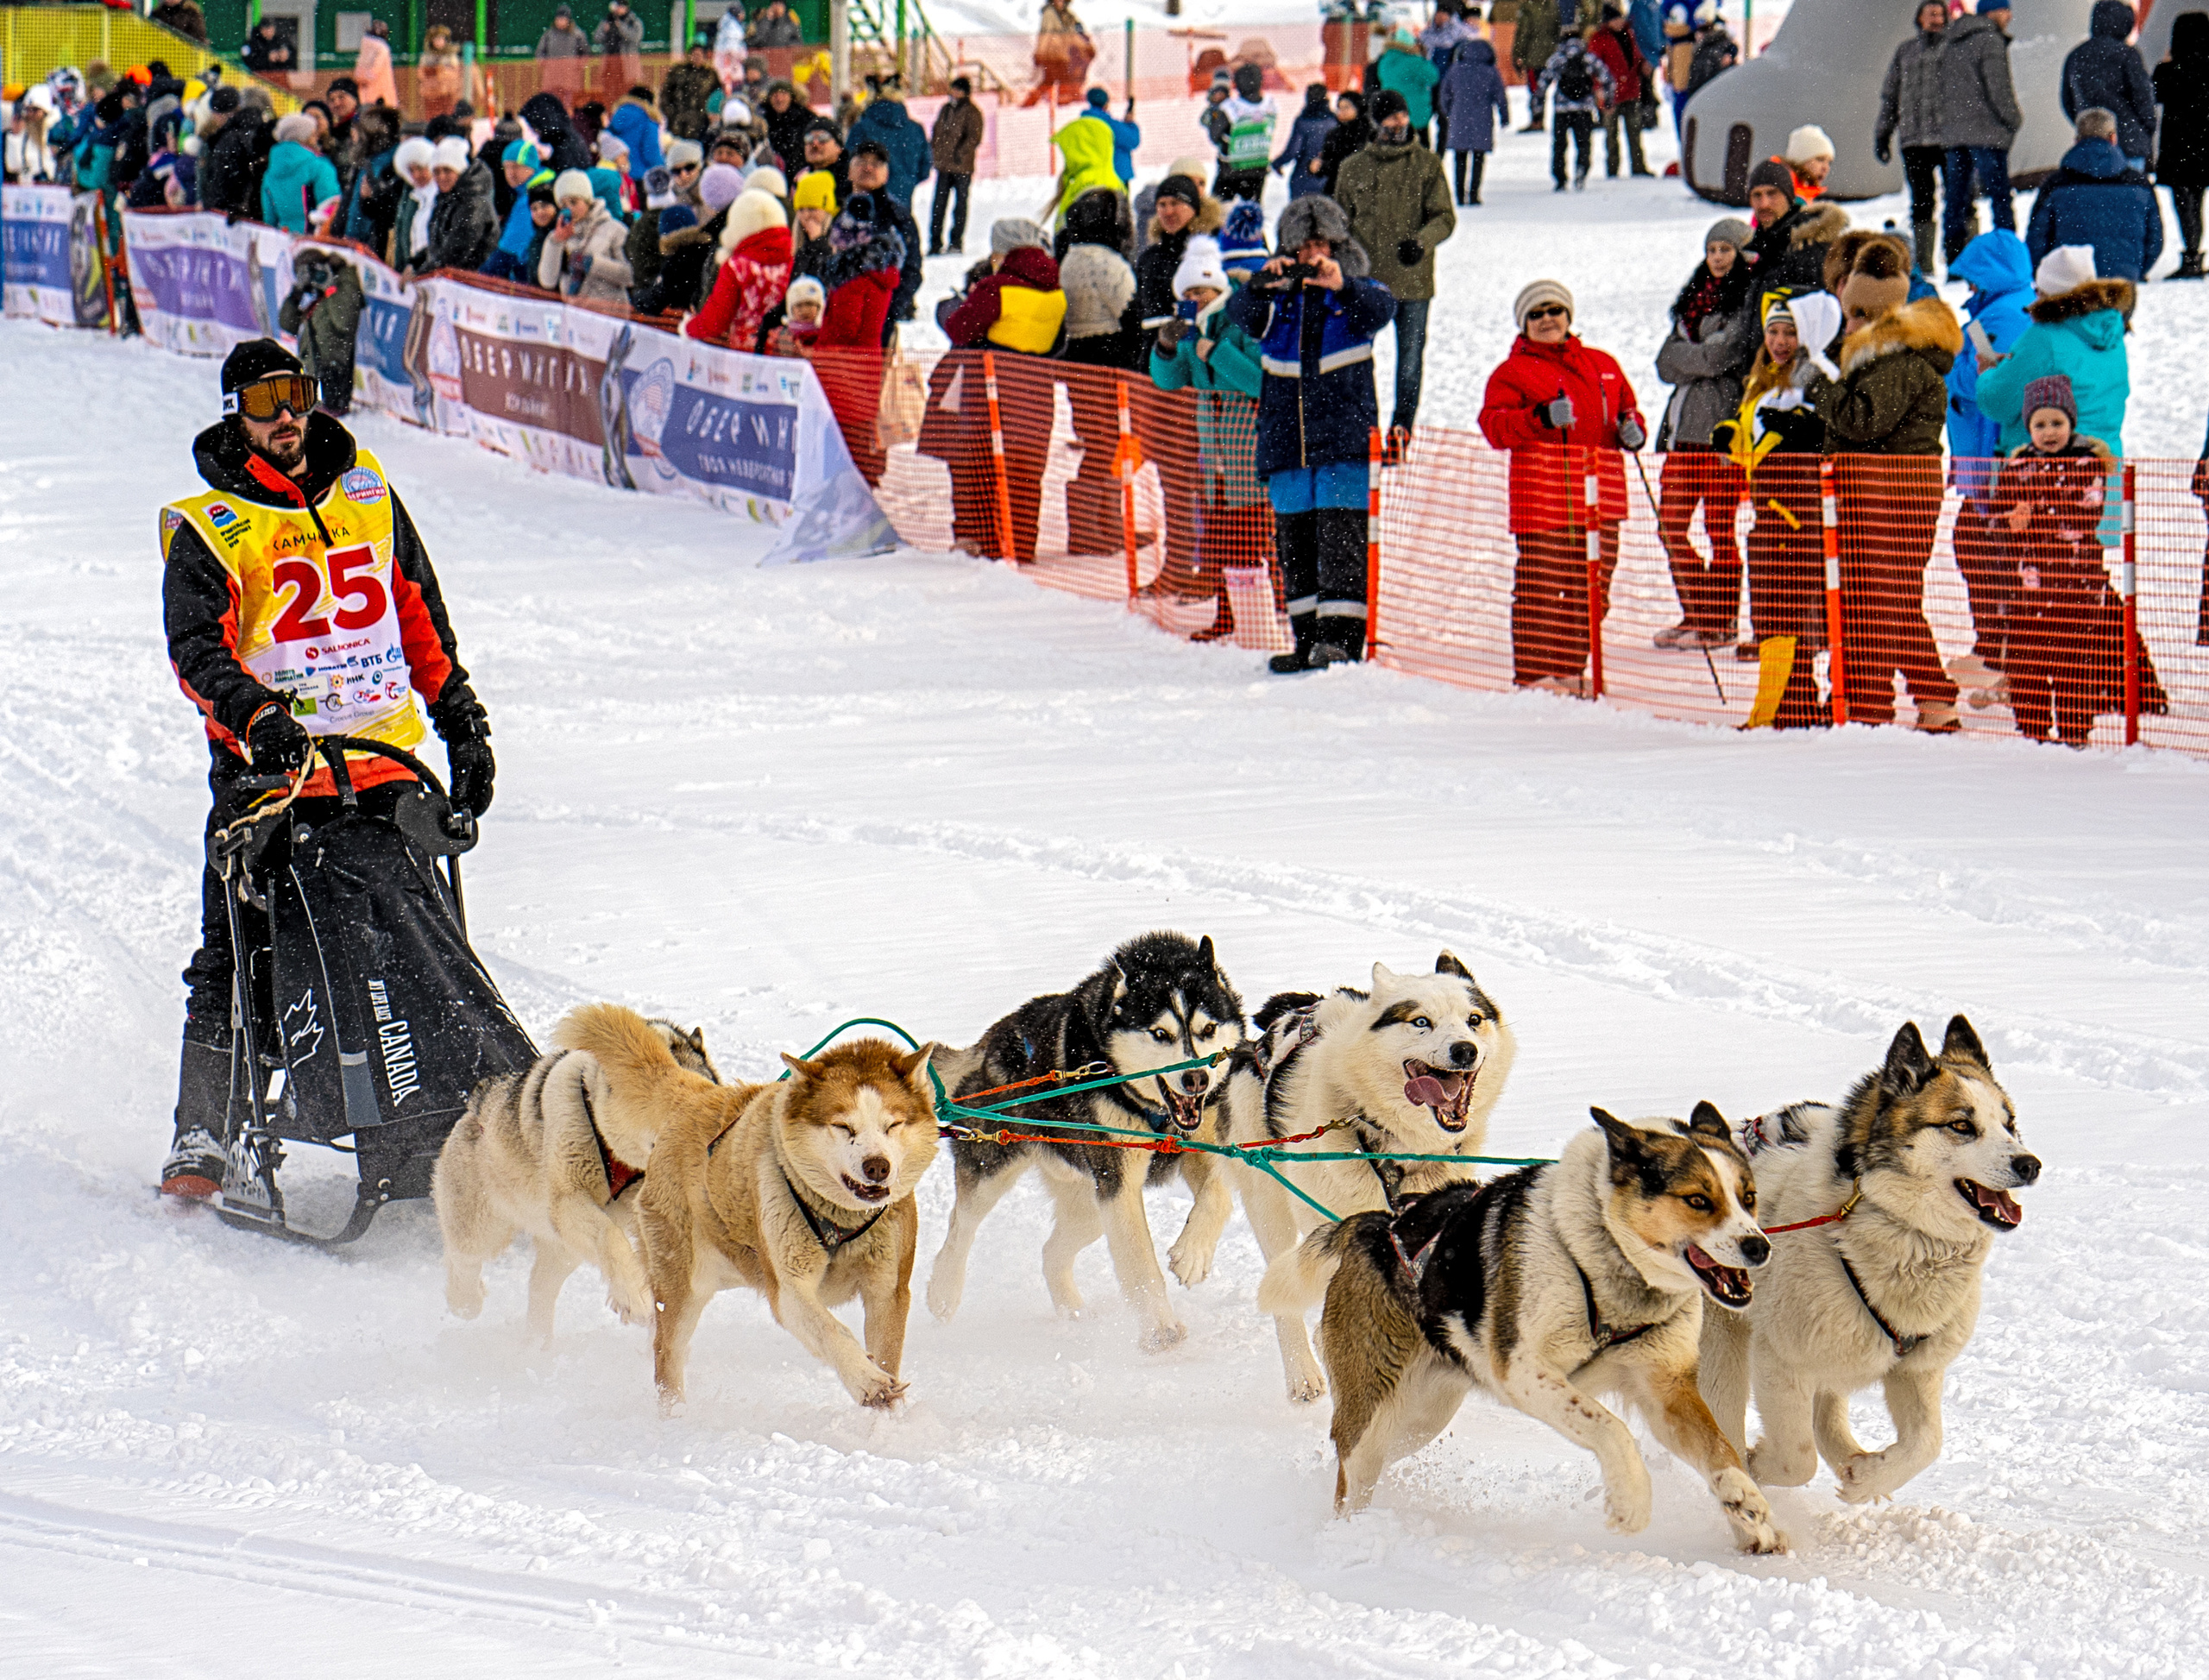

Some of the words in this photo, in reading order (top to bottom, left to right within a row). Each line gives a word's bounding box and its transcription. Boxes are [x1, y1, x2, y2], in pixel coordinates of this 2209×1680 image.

[270, 544, 388, 645] 25
[361, 653, 383, 669] ВТБ
[378, 1020, 421, 1108] CANADA
